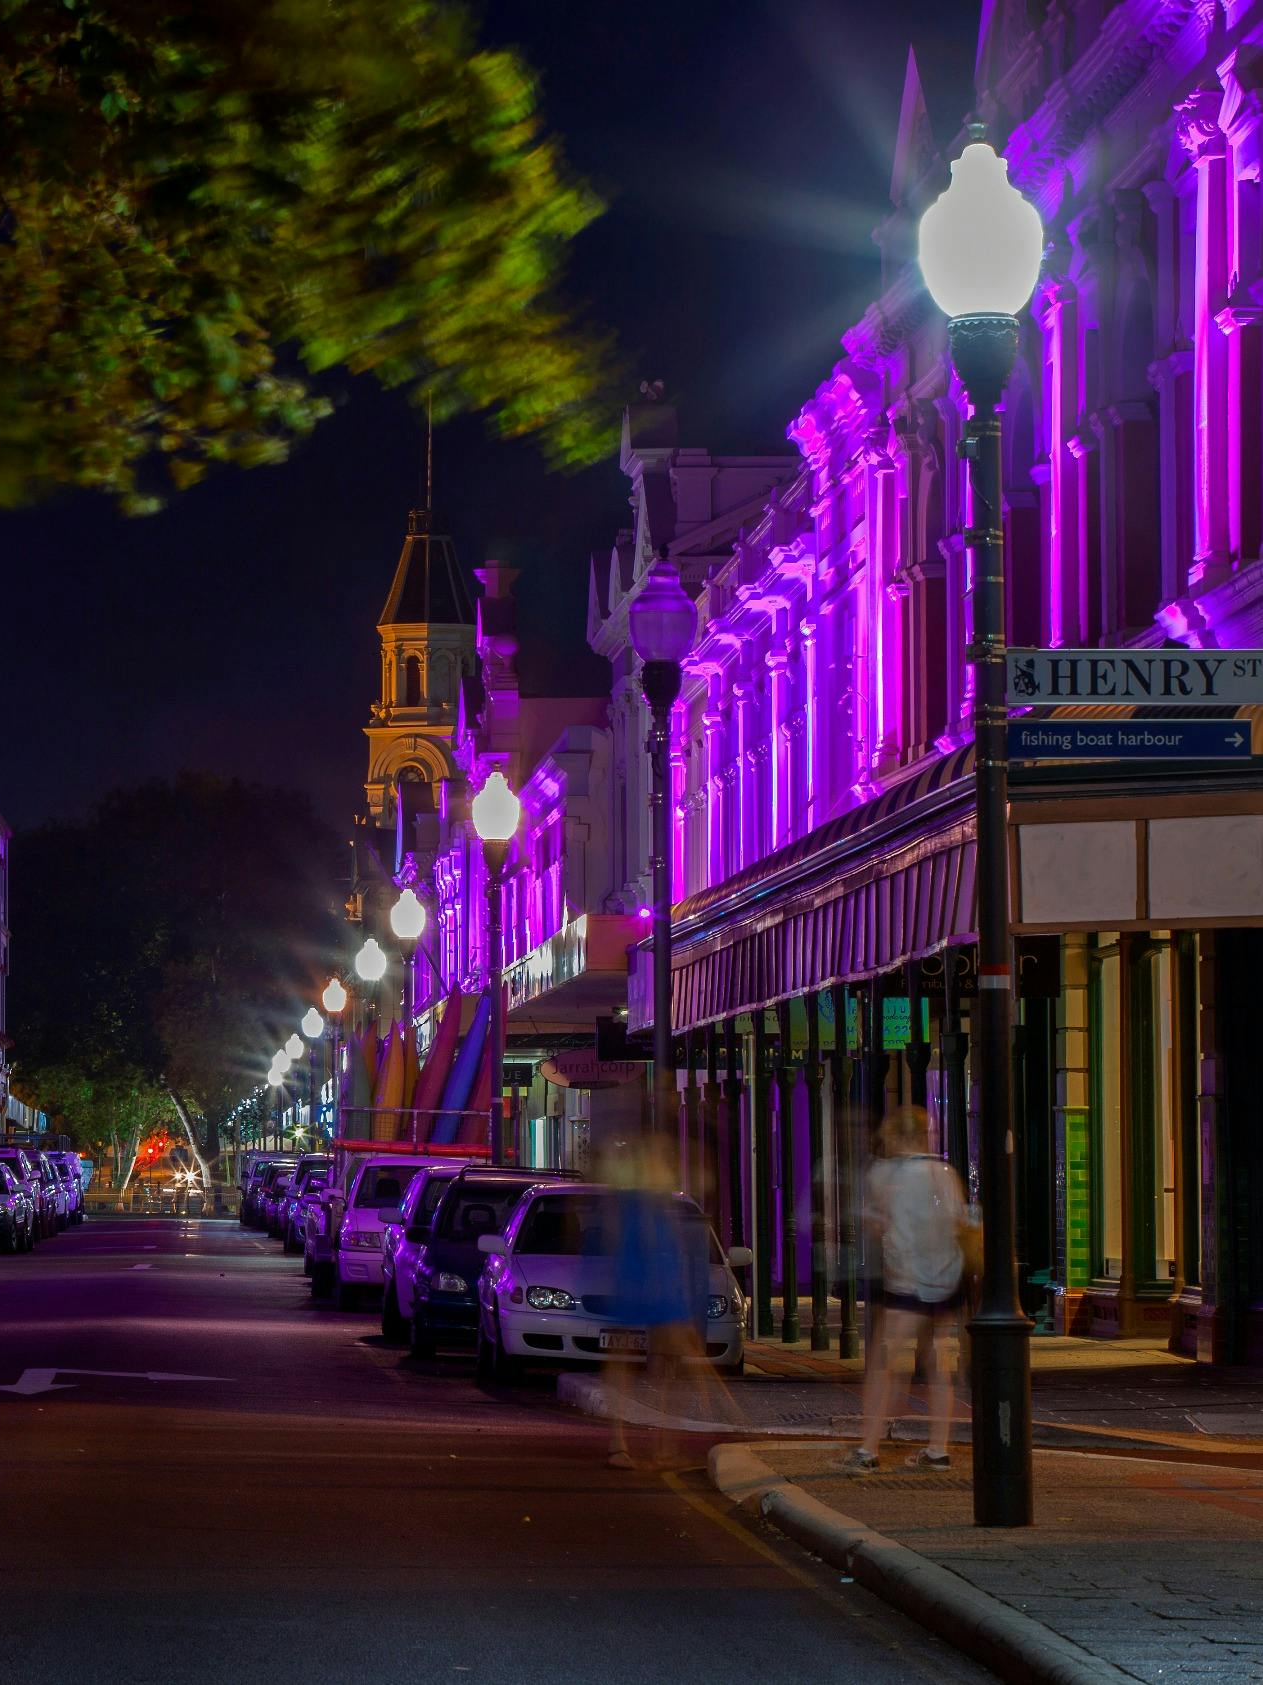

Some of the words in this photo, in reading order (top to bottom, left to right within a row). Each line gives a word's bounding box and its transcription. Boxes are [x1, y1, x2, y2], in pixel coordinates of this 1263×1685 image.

[1047, 658, 1227, 696] HENRY
[1233, 658, 1262, 678] ST
[1021, 731, 1072, 750] fishing
[1076, 731, 1113, 746] boat
[1117, 731, 1183, 746] harbour
